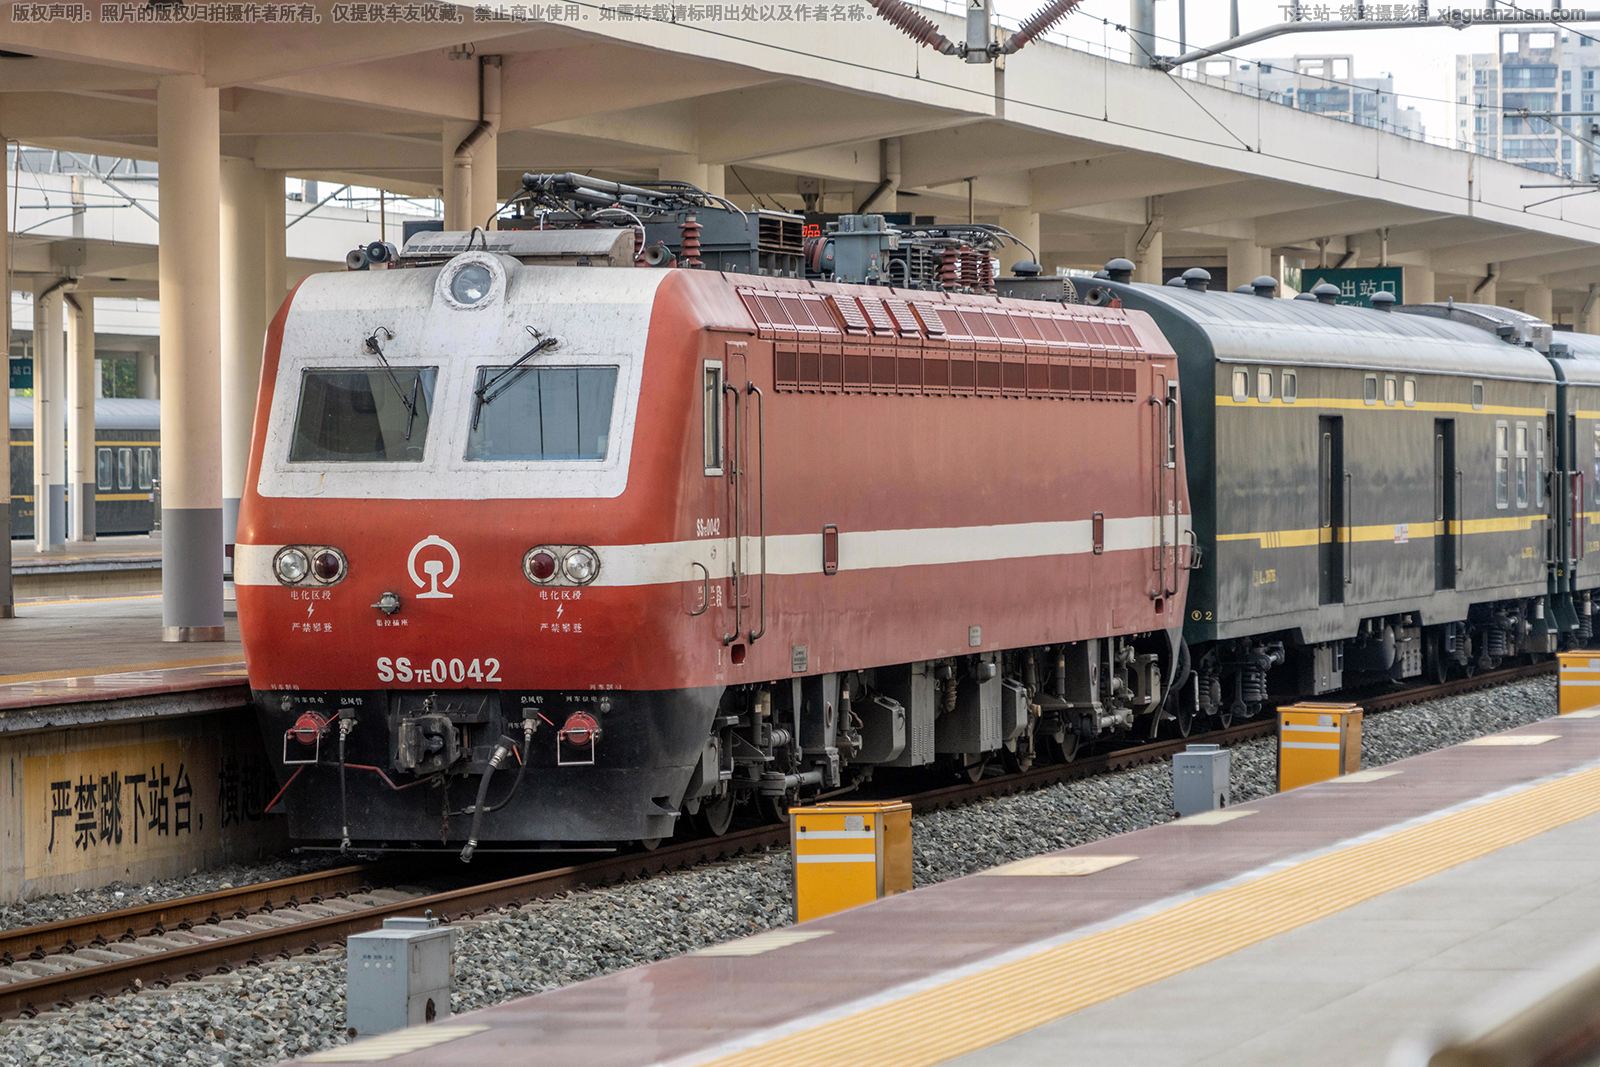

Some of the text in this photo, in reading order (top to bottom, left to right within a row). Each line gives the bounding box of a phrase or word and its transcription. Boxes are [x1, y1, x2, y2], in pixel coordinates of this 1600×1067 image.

[1341, 279, 1396, 297] 出站口
[9, 365, 31, 376] 站口
[290, 590, 332, 600] 电化区段
[539, 590, 582, 600] 电化区段
[1205, 611, 1213, 620] 2
[291, 622, 333, 633] 严禁攀登
[540, 622, 583, 633] 严禁攀登
[376, 656, 502, 683] SS7E0042
